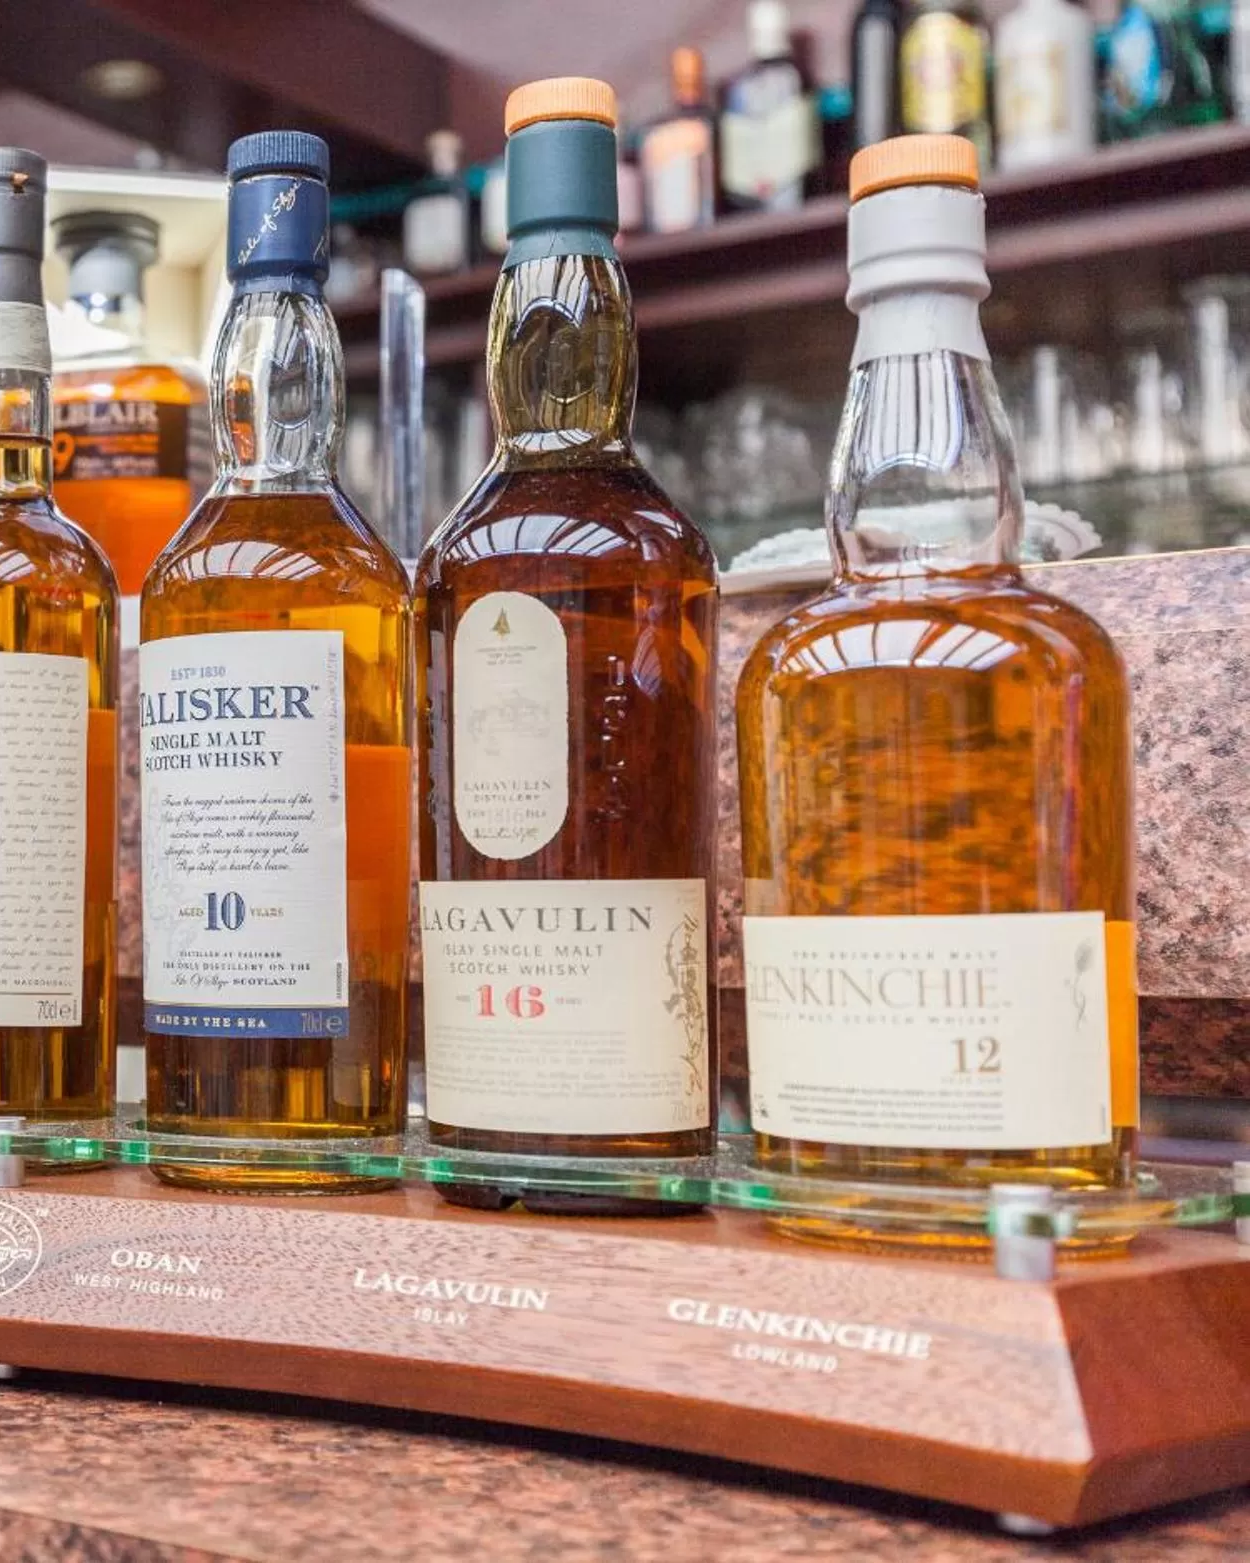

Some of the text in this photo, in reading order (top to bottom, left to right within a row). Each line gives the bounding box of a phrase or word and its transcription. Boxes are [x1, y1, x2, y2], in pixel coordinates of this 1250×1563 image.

[200, 666, 226, 678] 1830
[150, 731, 266, 750] SINGLE MALT
[198, 751, 283, 769] WHISKY
[299, 792, 312, 804] the
[204, 891, 246, 931] 10
[422, 906, 653, 932] LAGAVULIN
[482, 945, 543, 957] SINGLE
[555, 945, 604, 957] MALT
[448, 963, 590, 976] SCOTCH WHISKY
[476, 984, 546, 1018] 16
[184, 1016, 198, 1026] BY
[203, 1017, 231, 1027] THE
[237, 1018, 267, 1028] SEA
[951, 1036, 1001, 1074] 12
[110, 1248, 202, 1275] OBAN
[73, 1272, 225, 1302] WEST HIGHLAND
[352, 1267, 550, 1311] LAGAVULIN
[413, 1307, 468, 1327] ISLAY
[666, 1298, 932, 1360] GLENKINCHIE
[732, 1342, 838, 1373] LOWLAND
